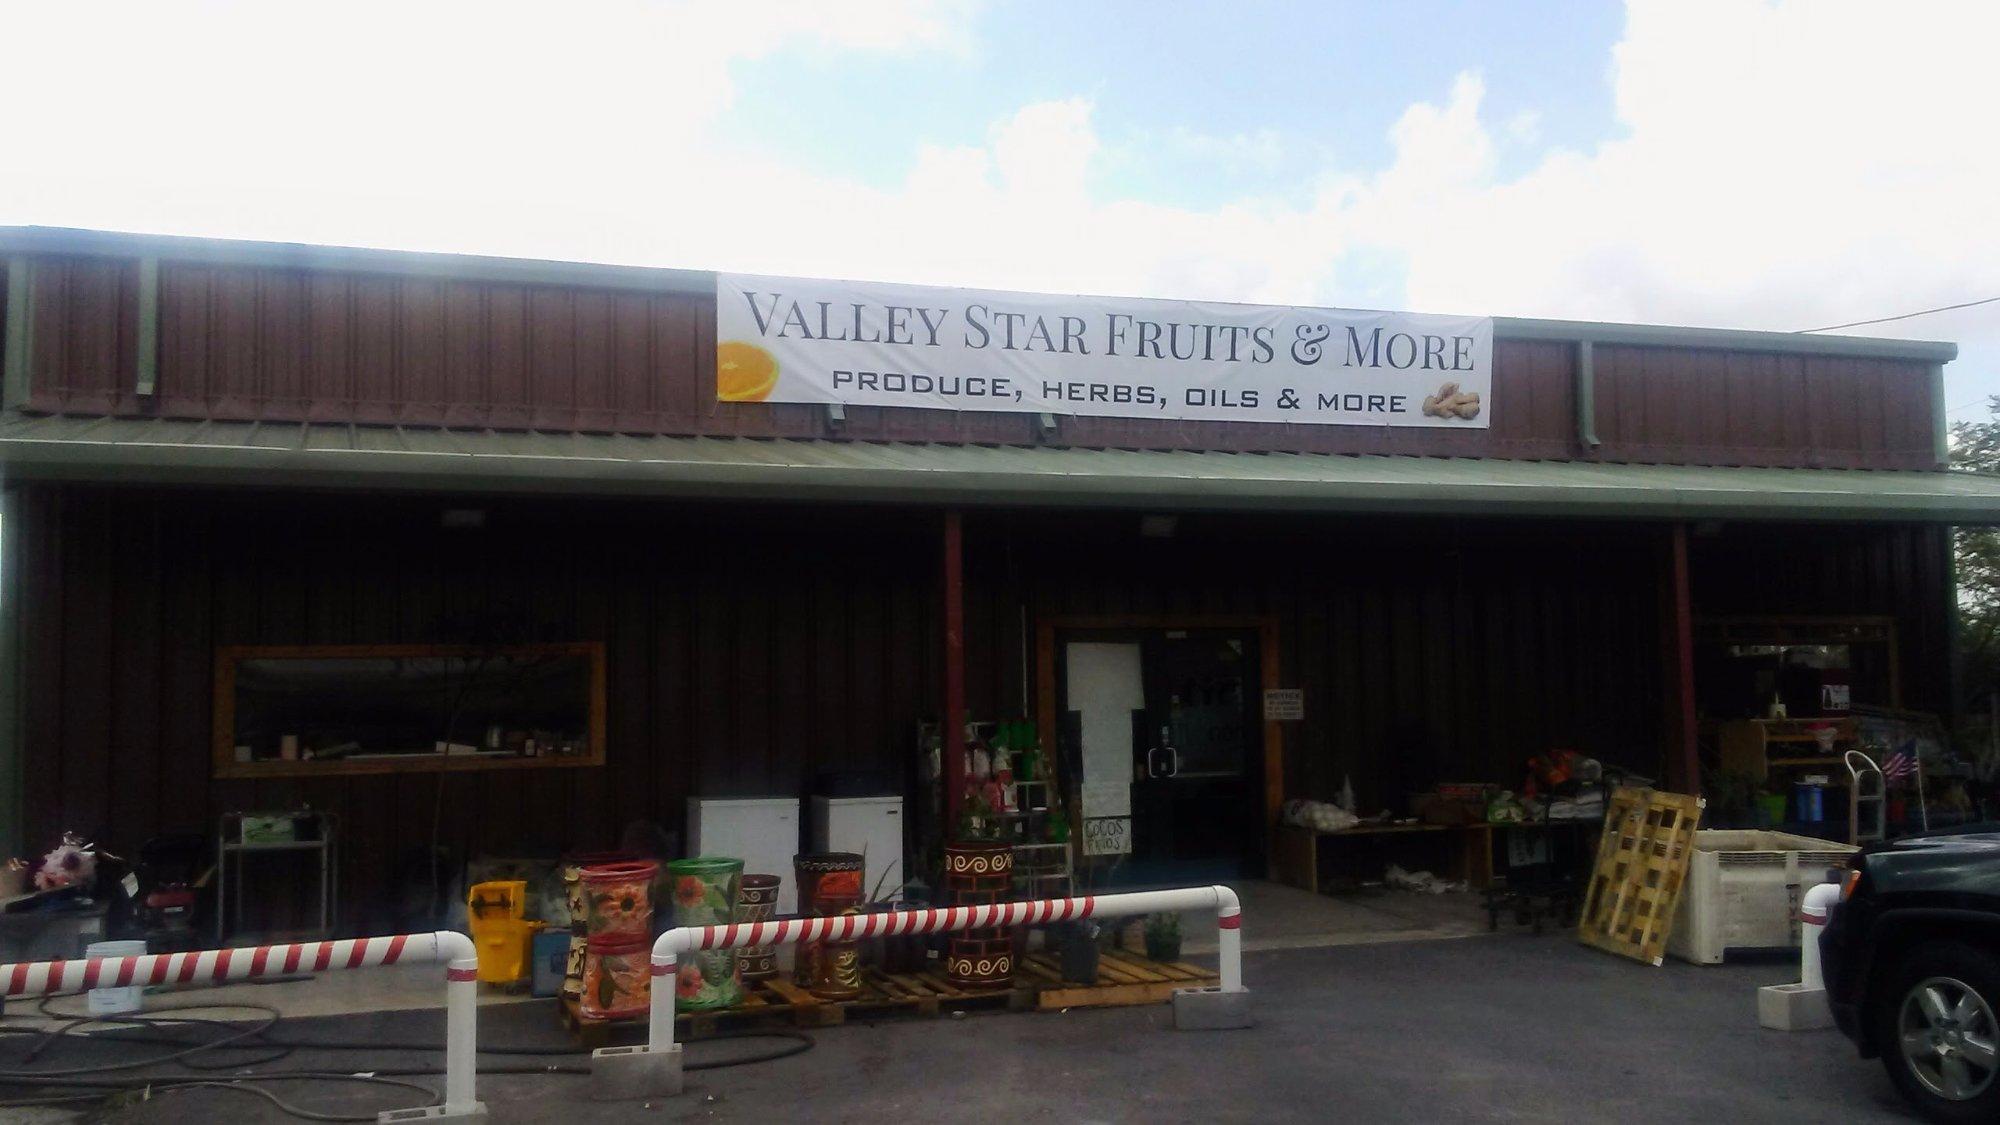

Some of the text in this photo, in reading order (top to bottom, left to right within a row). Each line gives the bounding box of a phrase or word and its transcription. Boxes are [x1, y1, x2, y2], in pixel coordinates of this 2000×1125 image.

[743, 291, 1475, 371] VALLEY STAR FRUITS & MORE
[832, 369, 1407, 413] PRODUCE, HERBS, OILS & MORE
